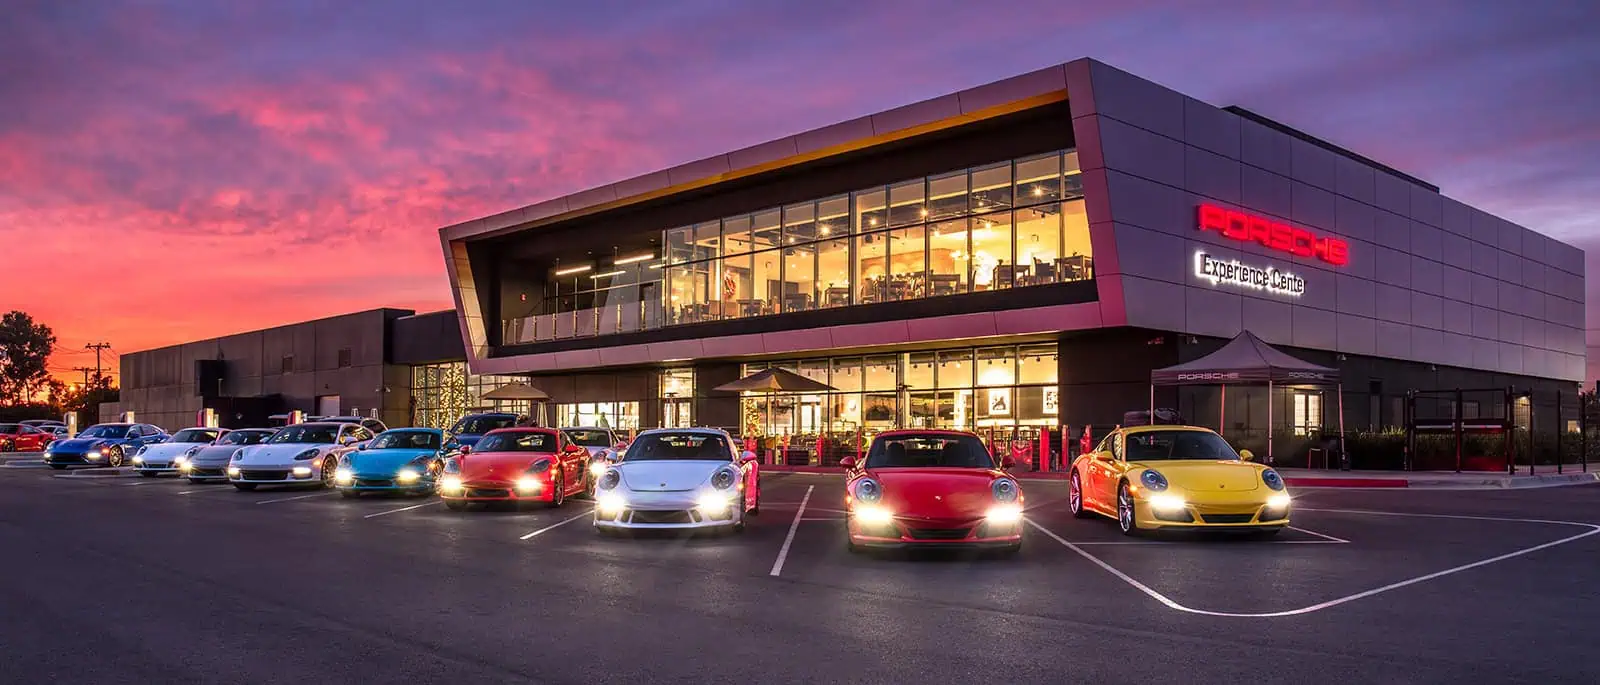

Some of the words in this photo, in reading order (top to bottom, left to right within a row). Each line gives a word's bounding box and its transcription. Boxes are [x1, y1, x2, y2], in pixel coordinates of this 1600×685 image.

[1198, 203, 1349, 265] PORSCHE
[1199, 253, 1269, 286] Experience
[1271, 268, 1307, 294] Center
[1177, 372, 1240, 380] PORSCHE
[1288, 371, 1325, 379] PORSCHE
